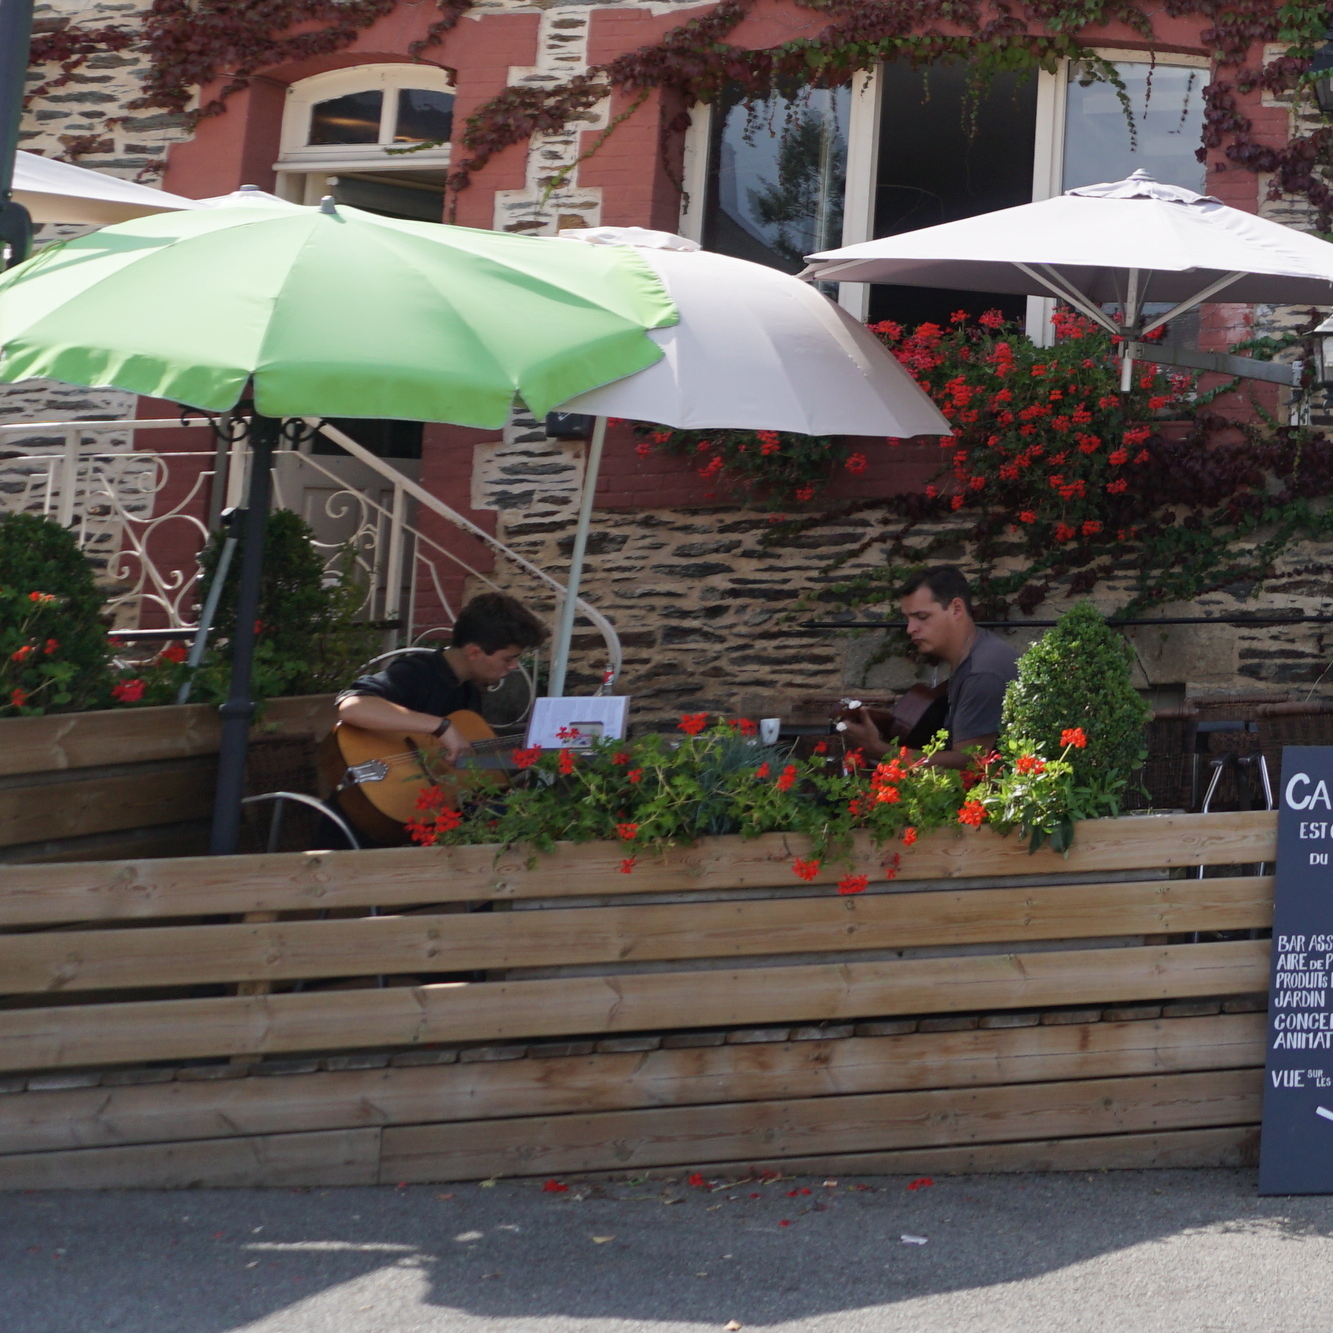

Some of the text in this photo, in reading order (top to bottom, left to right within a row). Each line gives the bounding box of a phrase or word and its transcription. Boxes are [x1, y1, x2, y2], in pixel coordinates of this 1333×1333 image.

[1299, 822, 1328, 839] EST
[1309, 853, 1328, 865] DU
[1278, 935, 1306, 952] BAR
[1276, 952, 1308, 970] AIRE
[1309, 959, 1324, 970] DE
[1274, 990, 1326, 1008] JARDIN
[1271, 1070, 1306, 1088] VUE
[1307, 1069, 1323, 1078] SUR
[1316, 1076, 1332, 1087] LES
